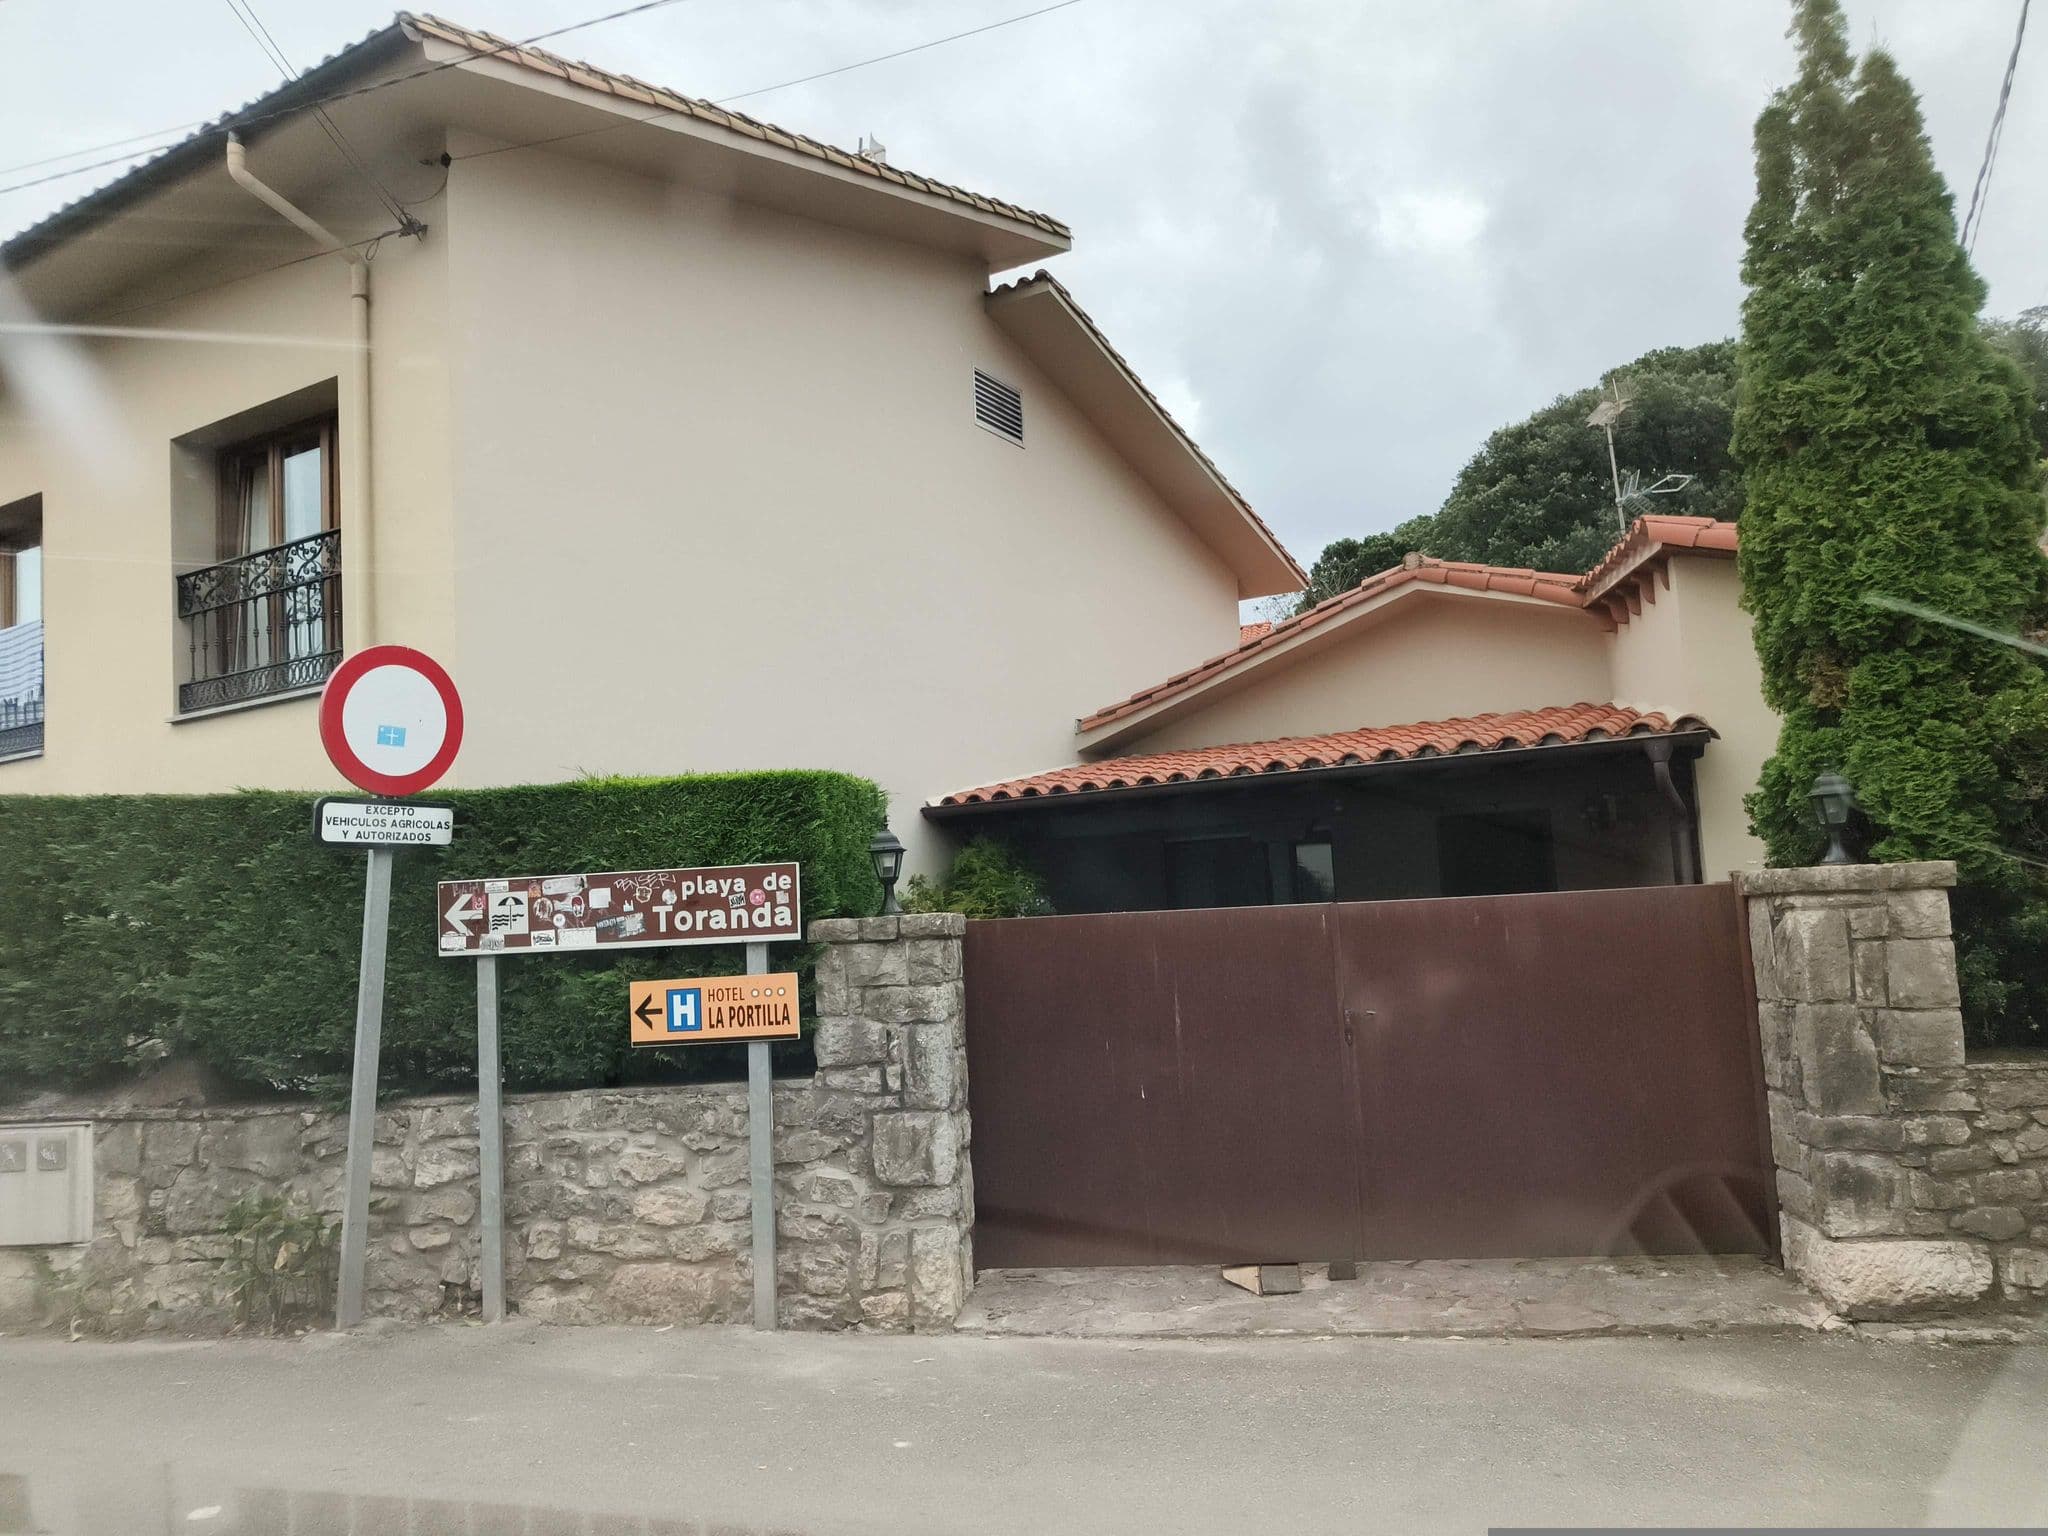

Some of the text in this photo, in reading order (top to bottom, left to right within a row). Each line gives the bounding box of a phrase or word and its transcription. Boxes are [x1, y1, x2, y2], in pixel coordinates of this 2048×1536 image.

[365, 805, 415, 816] EXCEPTO
[325, 816, 450, 830] VEHICULOS AGRICOLAS
[342, 830, 432, 841] Y AUTORIZADOS
[681, 875, 746, 901] playa
[762, 872, 792, 891] de
[652, 902, 793, 933] Toranda
[707, 987, 745, 1002] HOTEL
[672, 993, 696, 1027] H
[708, 1003, 791, 1029] LA PORTILLA
